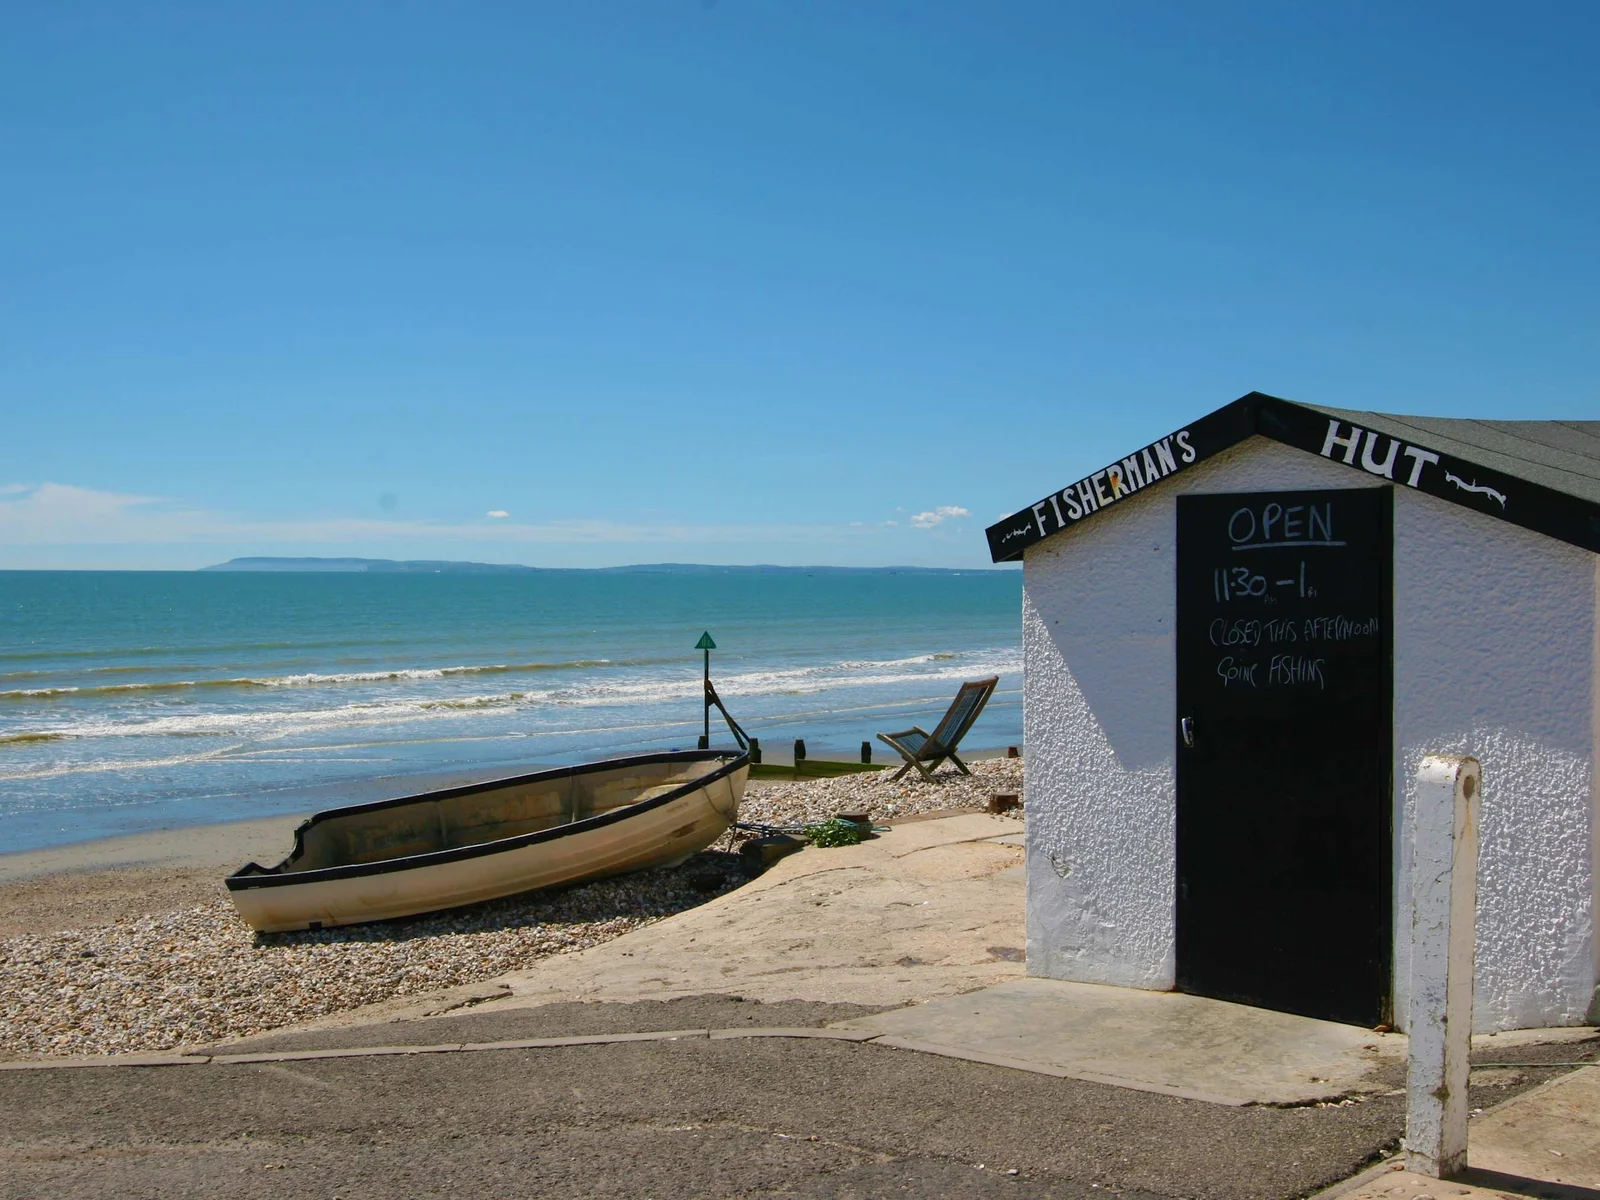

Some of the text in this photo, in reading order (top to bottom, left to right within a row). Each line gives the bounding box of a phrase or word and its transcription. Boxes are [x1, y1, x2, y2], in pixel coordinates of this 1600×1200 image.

[1320, 419, 1440, 488] HUT
[1032, 431, 1196, 537] FISHERMAN'S
[1228, 503, 1332, 543] OPEN
[1209, 614, 1379, 646] CLOSED THIS AFTERNOON
[1217, 653, 1325, 690] GOING FISHING
